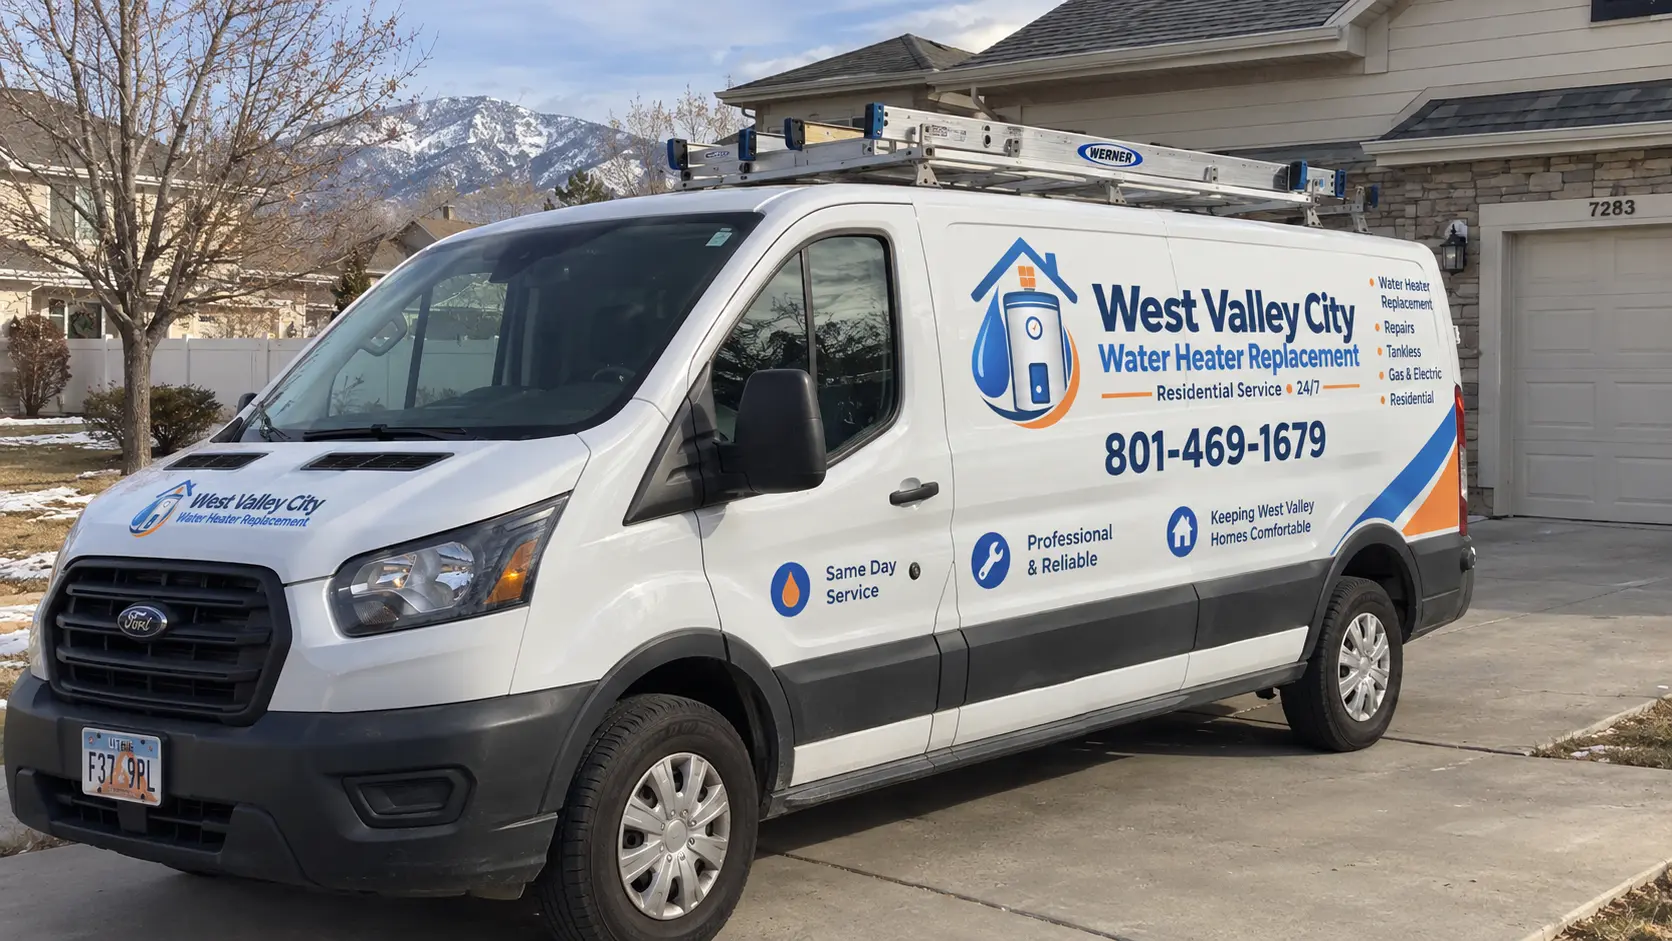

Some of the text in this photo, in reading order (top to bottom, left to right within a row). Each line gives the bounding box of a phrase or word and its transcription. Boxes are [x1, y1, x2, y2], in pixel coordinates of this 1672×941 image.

[1089, 147, 1133, 164] WERNER
[1589, 199, 1636, 217] 7283
[1378, 276, 1430, 292] Water Heater
[1092, 283, 1356, 343] West Valley City
[1381, 295, 1433, 311] Replacement
[1384, 320, 1415, 336] Repairs
[1098, 342, 1360, 376] Water Heater Replacement
[1386, 344, 1422, 359] Tankless
[1388, 366, 1443, 382] Gas & Electric
[1156, 380, 1320, 402] Residential Service 24/7
[1390, 391, 1435, 407] Residential
[1104, 420, 1327, 477] 801-469-1679
[189, 493, 327, 517] West Valley City
[1210, 499, 1315, 526] Keeping West Valley
[175, 511, 311, 528] Water Heater Replacement
[1028, 523, 1114, 552] Professional
[1210, 520, 1312, 547] Homes Comfortable
[825, 559, 897, 582] Same Day
[1027, 551, 1099, 577] & Reliable
[826, 583, 880, 605] Service
[124, 610, 153, 632] Ford
[88, 751, 156, 793] F37 9PL
